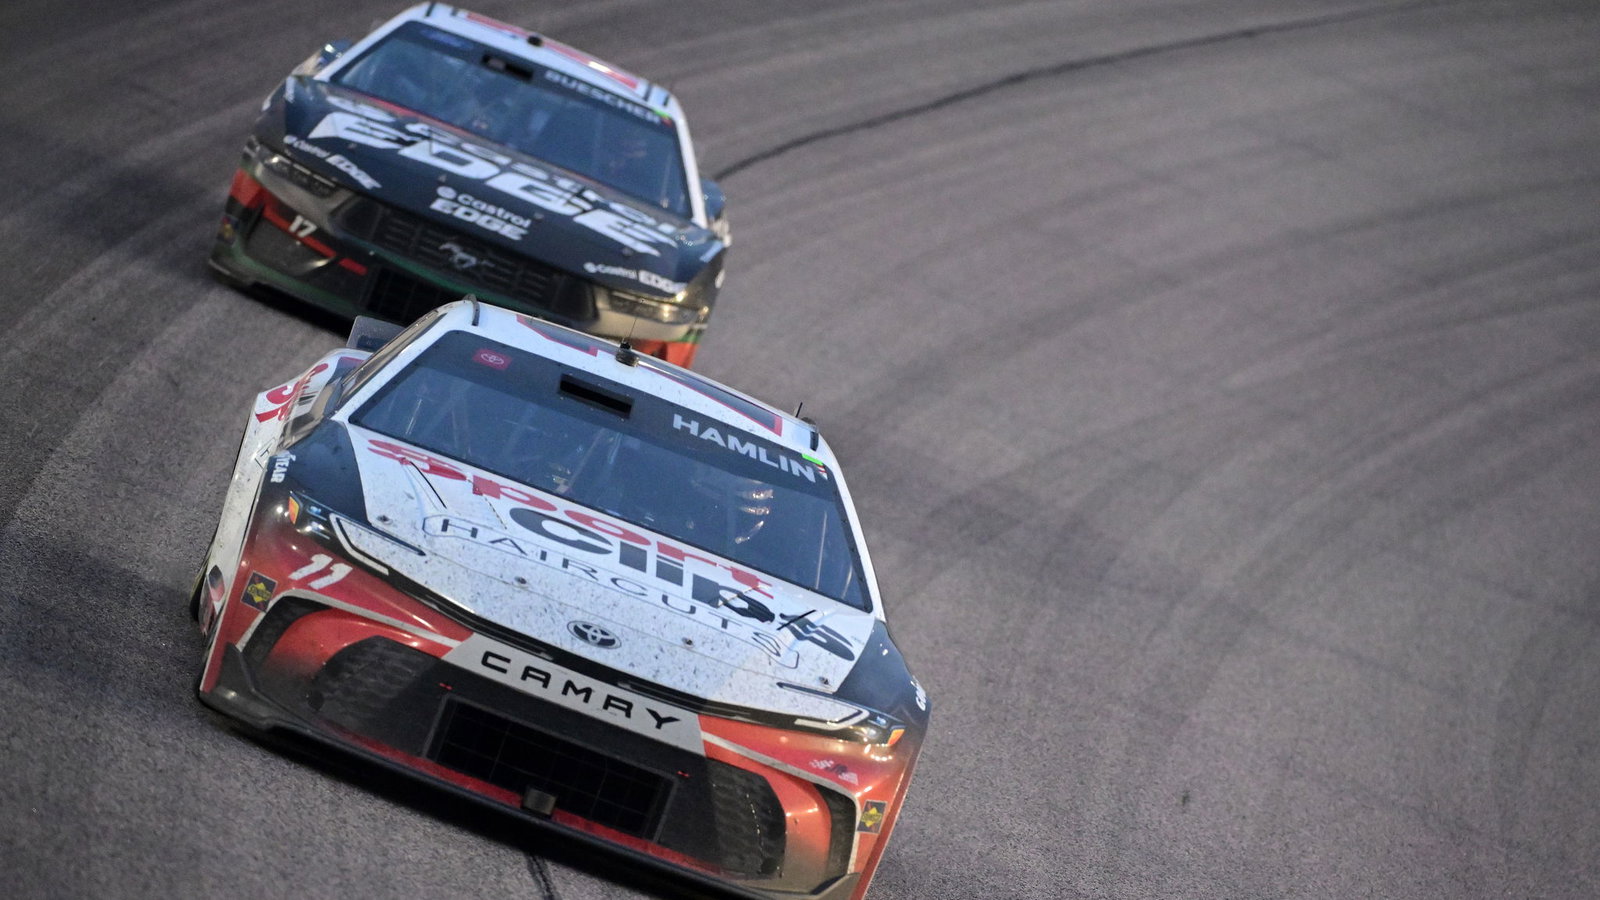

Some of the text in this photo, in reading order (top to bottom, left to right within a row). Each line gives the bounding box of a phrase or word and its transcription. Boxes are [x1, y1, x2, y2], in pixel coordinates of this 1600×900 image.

[544, 69, 661, 124] BUESCHER
[307, 111, 679, 258] EDGE
[429, 198, 530, 241] EDGE
[457, 193, 532, 229] Castrol
[289, 214, 318, 239] 17
[673, 413, 817, 484] HAMLIN
[367, 438, 774, 600] Sport
[288, 553, 353, 590] 11
[440, 518, 782, 658] HAIRCUTS
[509, 506, 855, 662] Clips
[480, 650, 681, 730] CAMRY
